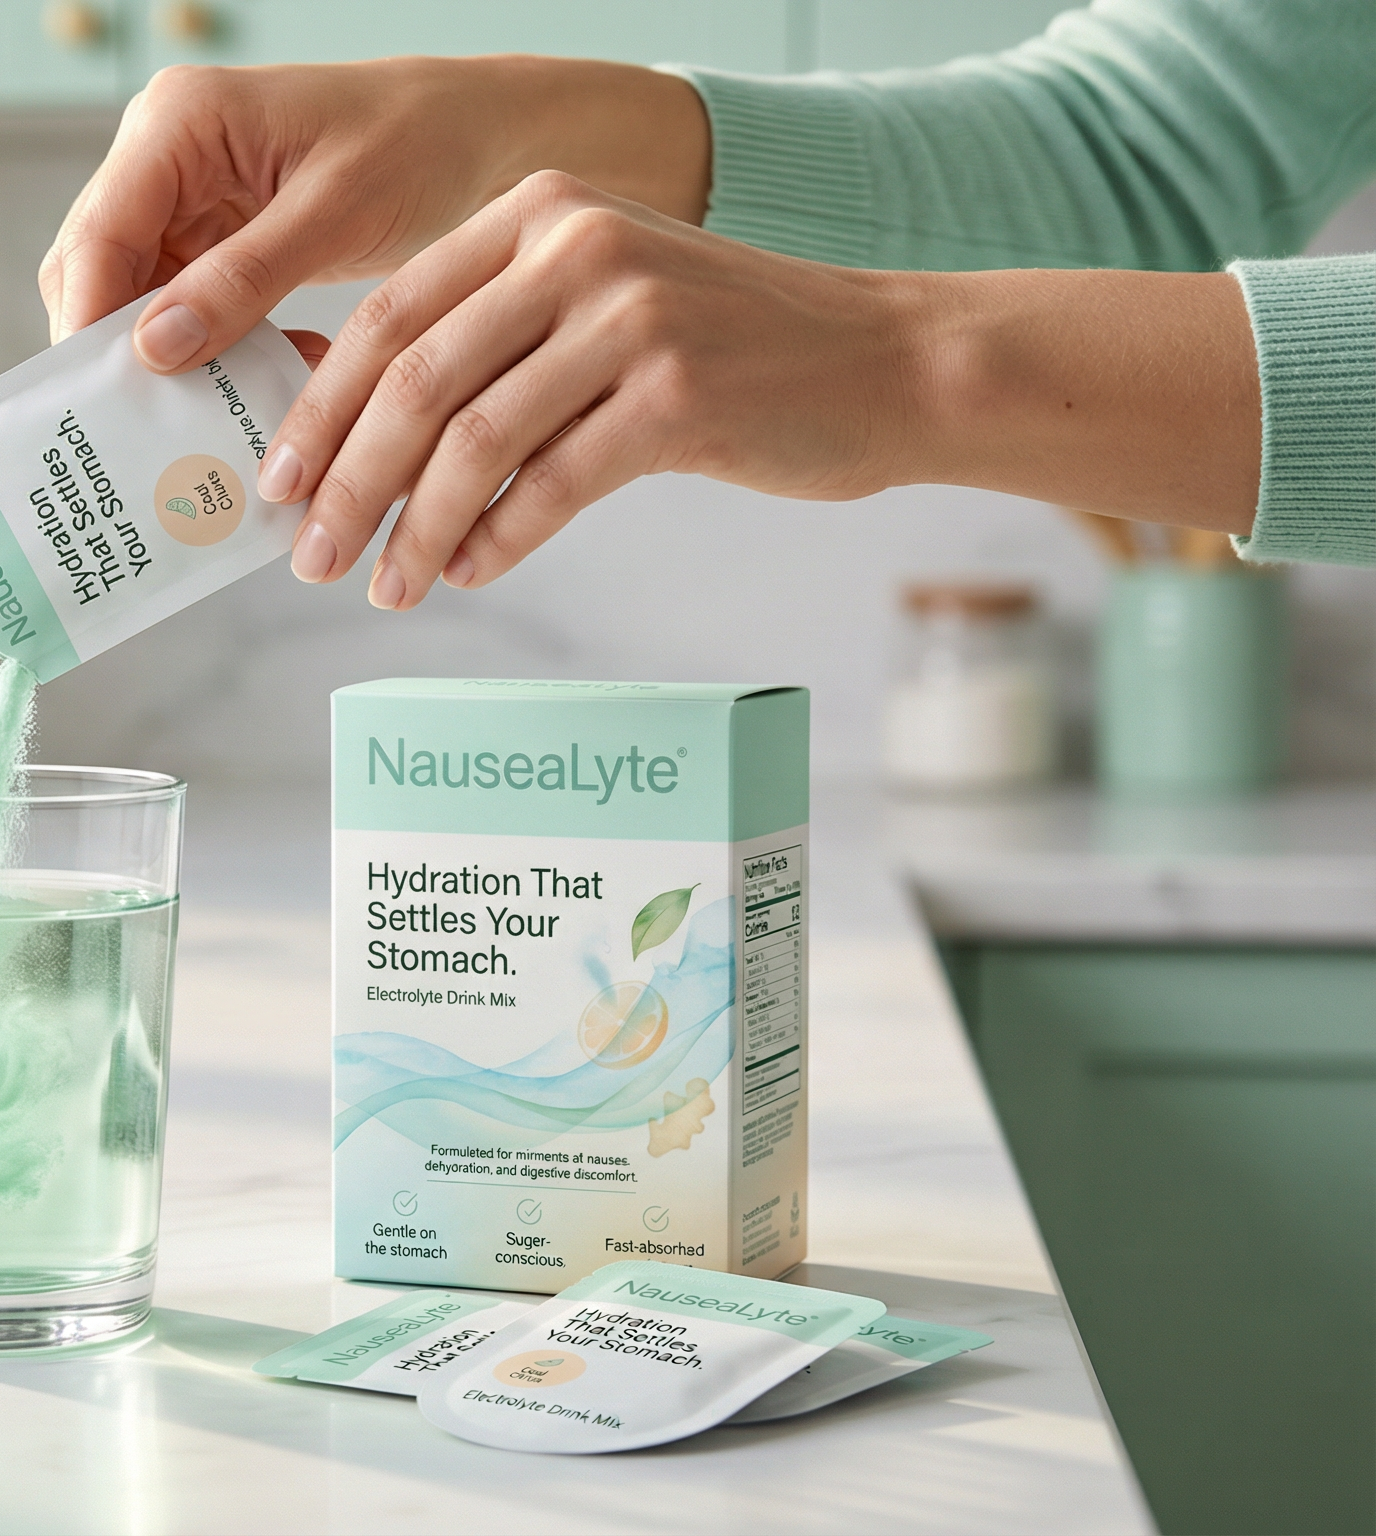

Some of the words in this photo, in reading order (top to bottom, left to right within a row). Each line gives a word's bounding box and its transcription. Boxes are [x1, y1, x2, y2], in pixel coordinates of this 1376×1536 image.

[57, 408, 124, 518] Stomach.
[42, 448, 95, 531] Settles
[29, 487, 101, 605] Hydration
[84, 532, 126, 592] That
[114, 521, 152, 577] Your
[368, 736, 679, 806] NauseaLyte
[368, 861, 521, 900] Hydration
[530, 867, 603, 900] That
[367, 901, 476, 935] Settles
[486, 906, 560, 938] Your
[367, 940, 517, 976] Stomach.
[367, 986, 443, 1007] Electrolyte
[447, 989, 485, 1006] Drink
[490, 992, 517, 1008] Mix
[496, 1147, 513, 1160] for
[572, 1152, 584, 1164] at
[496, 1165, 517, 1176] and
[373, 1222, 417, 1240] Gentle
[420, 1228, 437, 1240] on
[506, 1231, 551, 1250] Suger-
[365, 1241, 387, 1256] the
[390, 1243, 448, 1260] stomach
[575, 1307, 687, 1336] Hydration
[613, 1279, 808, 1326] NauseaLyte
[322, 1302, 461, 1366] NauseaLyte
[564, 1318, 615, 1337] That
[546, 1329, 599, 1347] Your
[599, 1339, 703, 1370] Stomach.
